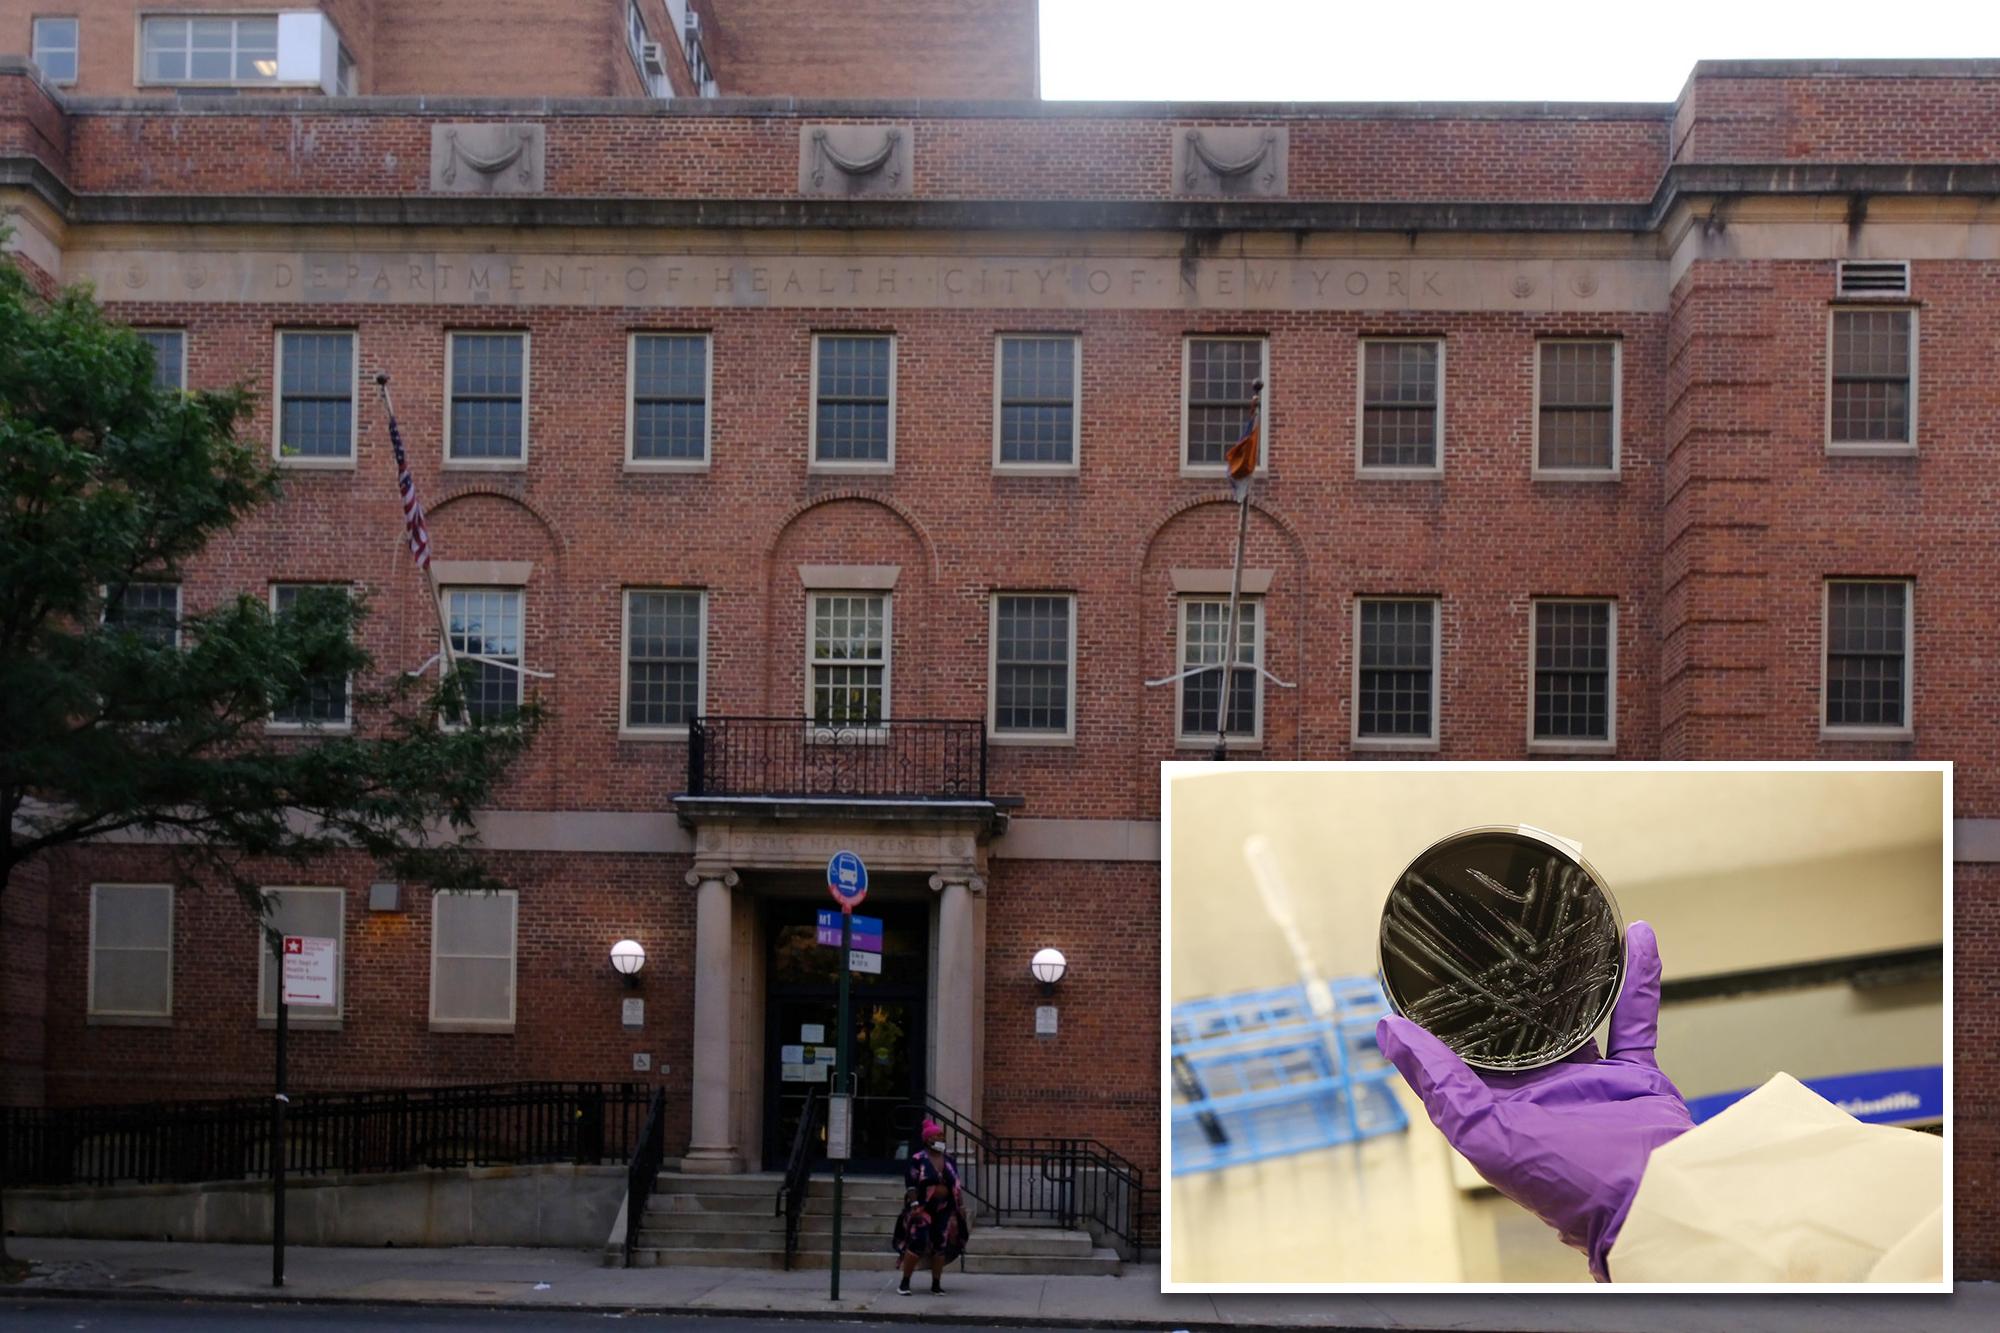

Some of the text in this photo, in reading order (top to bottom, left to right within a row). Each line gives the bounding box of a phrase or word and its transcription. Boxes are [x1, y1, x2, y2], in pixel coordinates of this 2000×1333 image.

[274, 264, 1444, 297] DEPARTMENT OF HEALTH CITY OF NEW YORK
[810, 838, 869, 851] HEALTH
[877, 839, 938, 852] CENTER
